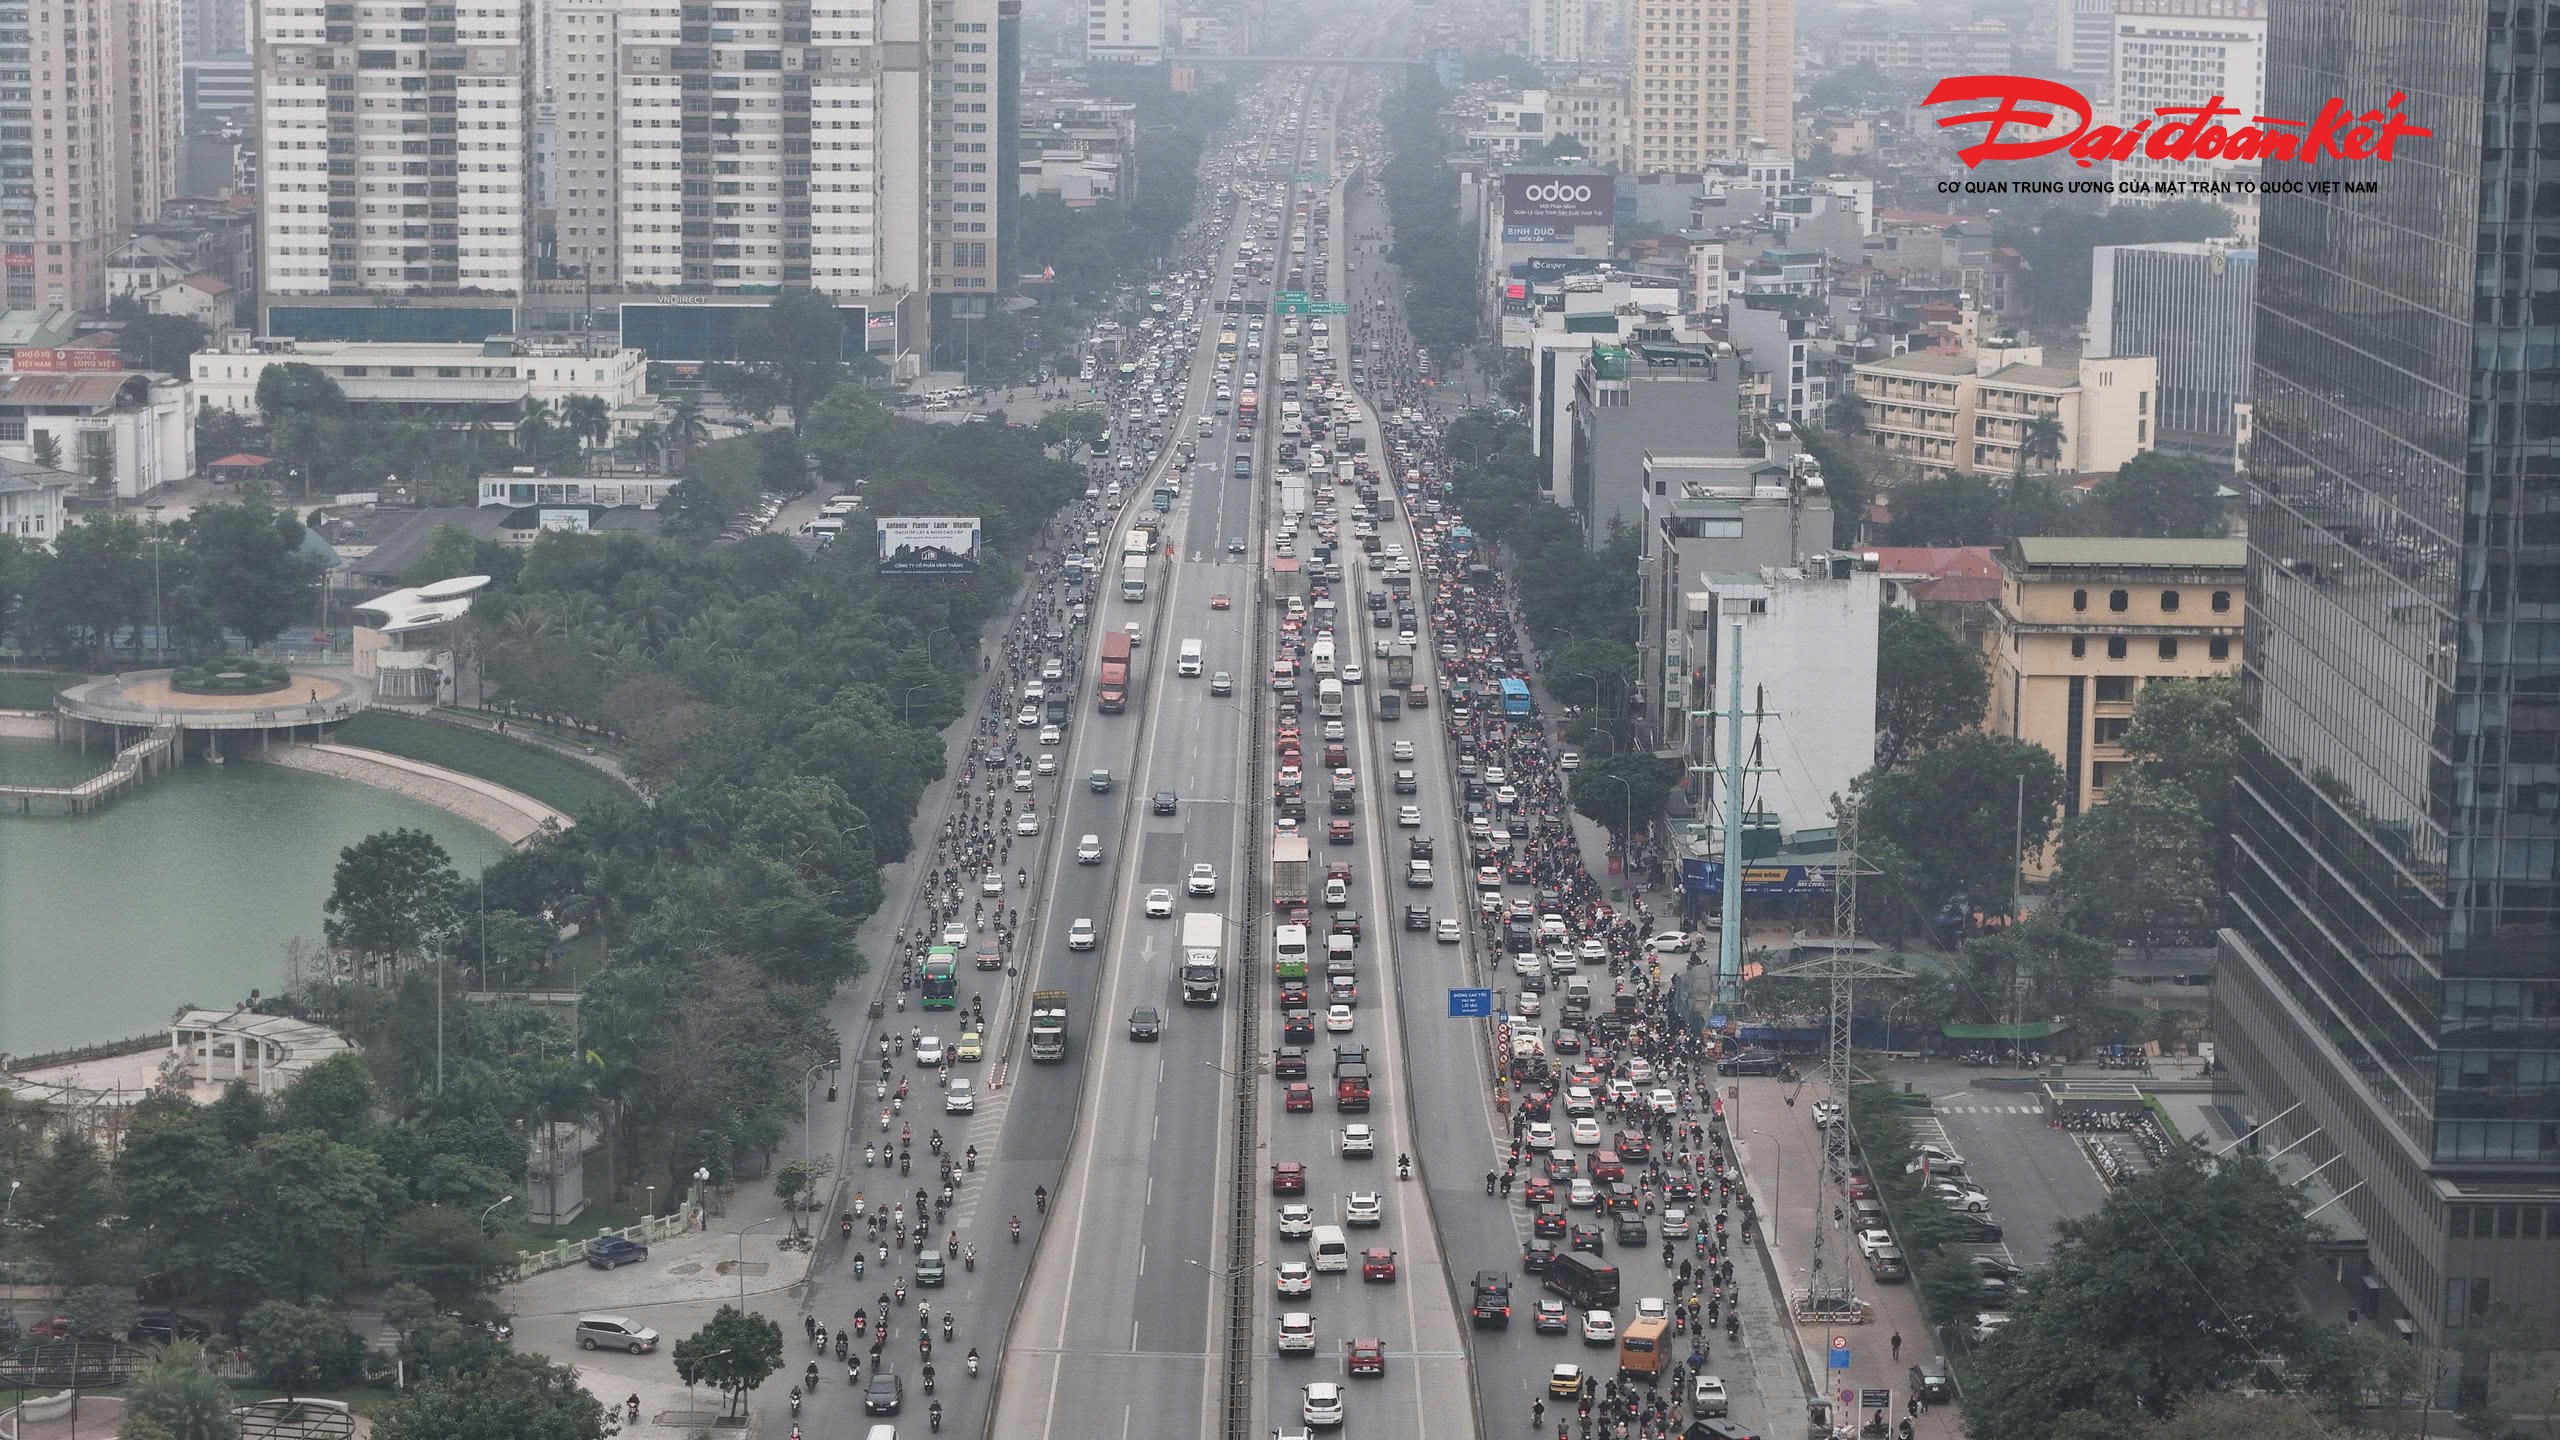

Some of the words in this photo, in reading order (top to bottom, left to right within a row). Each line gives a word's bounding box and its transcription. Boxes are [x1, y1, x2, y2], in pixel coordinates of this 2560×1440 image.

[1526, 180, 1591, 201] odoo
[1540, 261, 1567, 270] Casper
[657, 294, 707, 305] VNDIRECT
[17, 360, 33, 368] VIỆT
